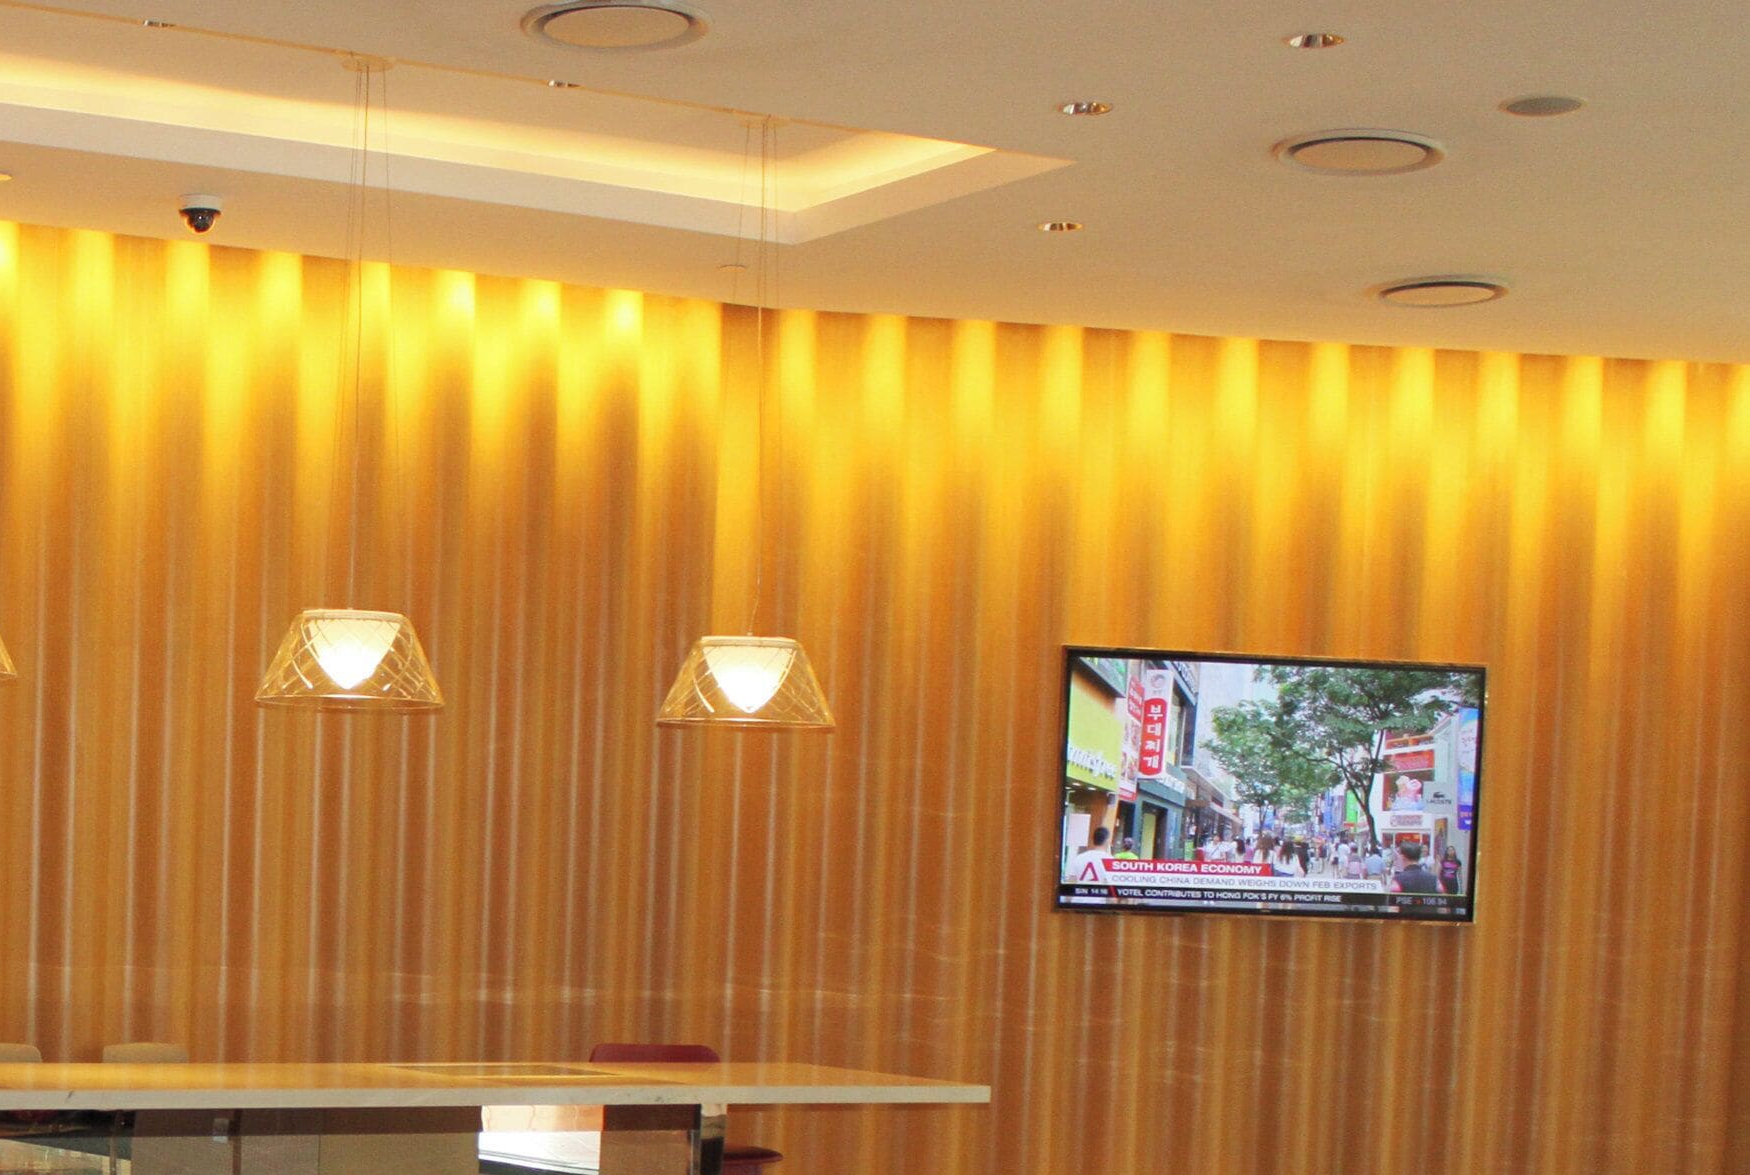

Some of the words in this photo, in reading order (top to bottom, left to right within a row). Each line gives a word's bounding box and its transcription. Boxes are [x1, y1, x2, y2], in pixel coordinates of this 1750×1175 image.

[1112, 862, 1153, 871] SOUTH
[1157, 863, 1198, 872] KOREA
[1201, 864, 1262, 874] ECONOMY
[1112, 875, 1156, 883] COOLING
[1159, 876, 1191, 885] CHINA
[1193, 877, 1235, 886] DEMAND
[1237, 879, 1276, 888] WEIGHS
[1279, 880, 1309, 889] DOWN
[1313, 881, 1331, 890] FEB
[1334, 881, 1377, 891] EXPORTS
[1145, 890, 1201, 898] CONTRIBUTES
[1216, 891, 1241, 900] HONG
[1242, 892, 1267, 901] FOK'S
[1268, 893, 1279, 901] FY
[1294, 894, 1323, 903] PROFIT
[1323, 894, 1342, 903] RISE
